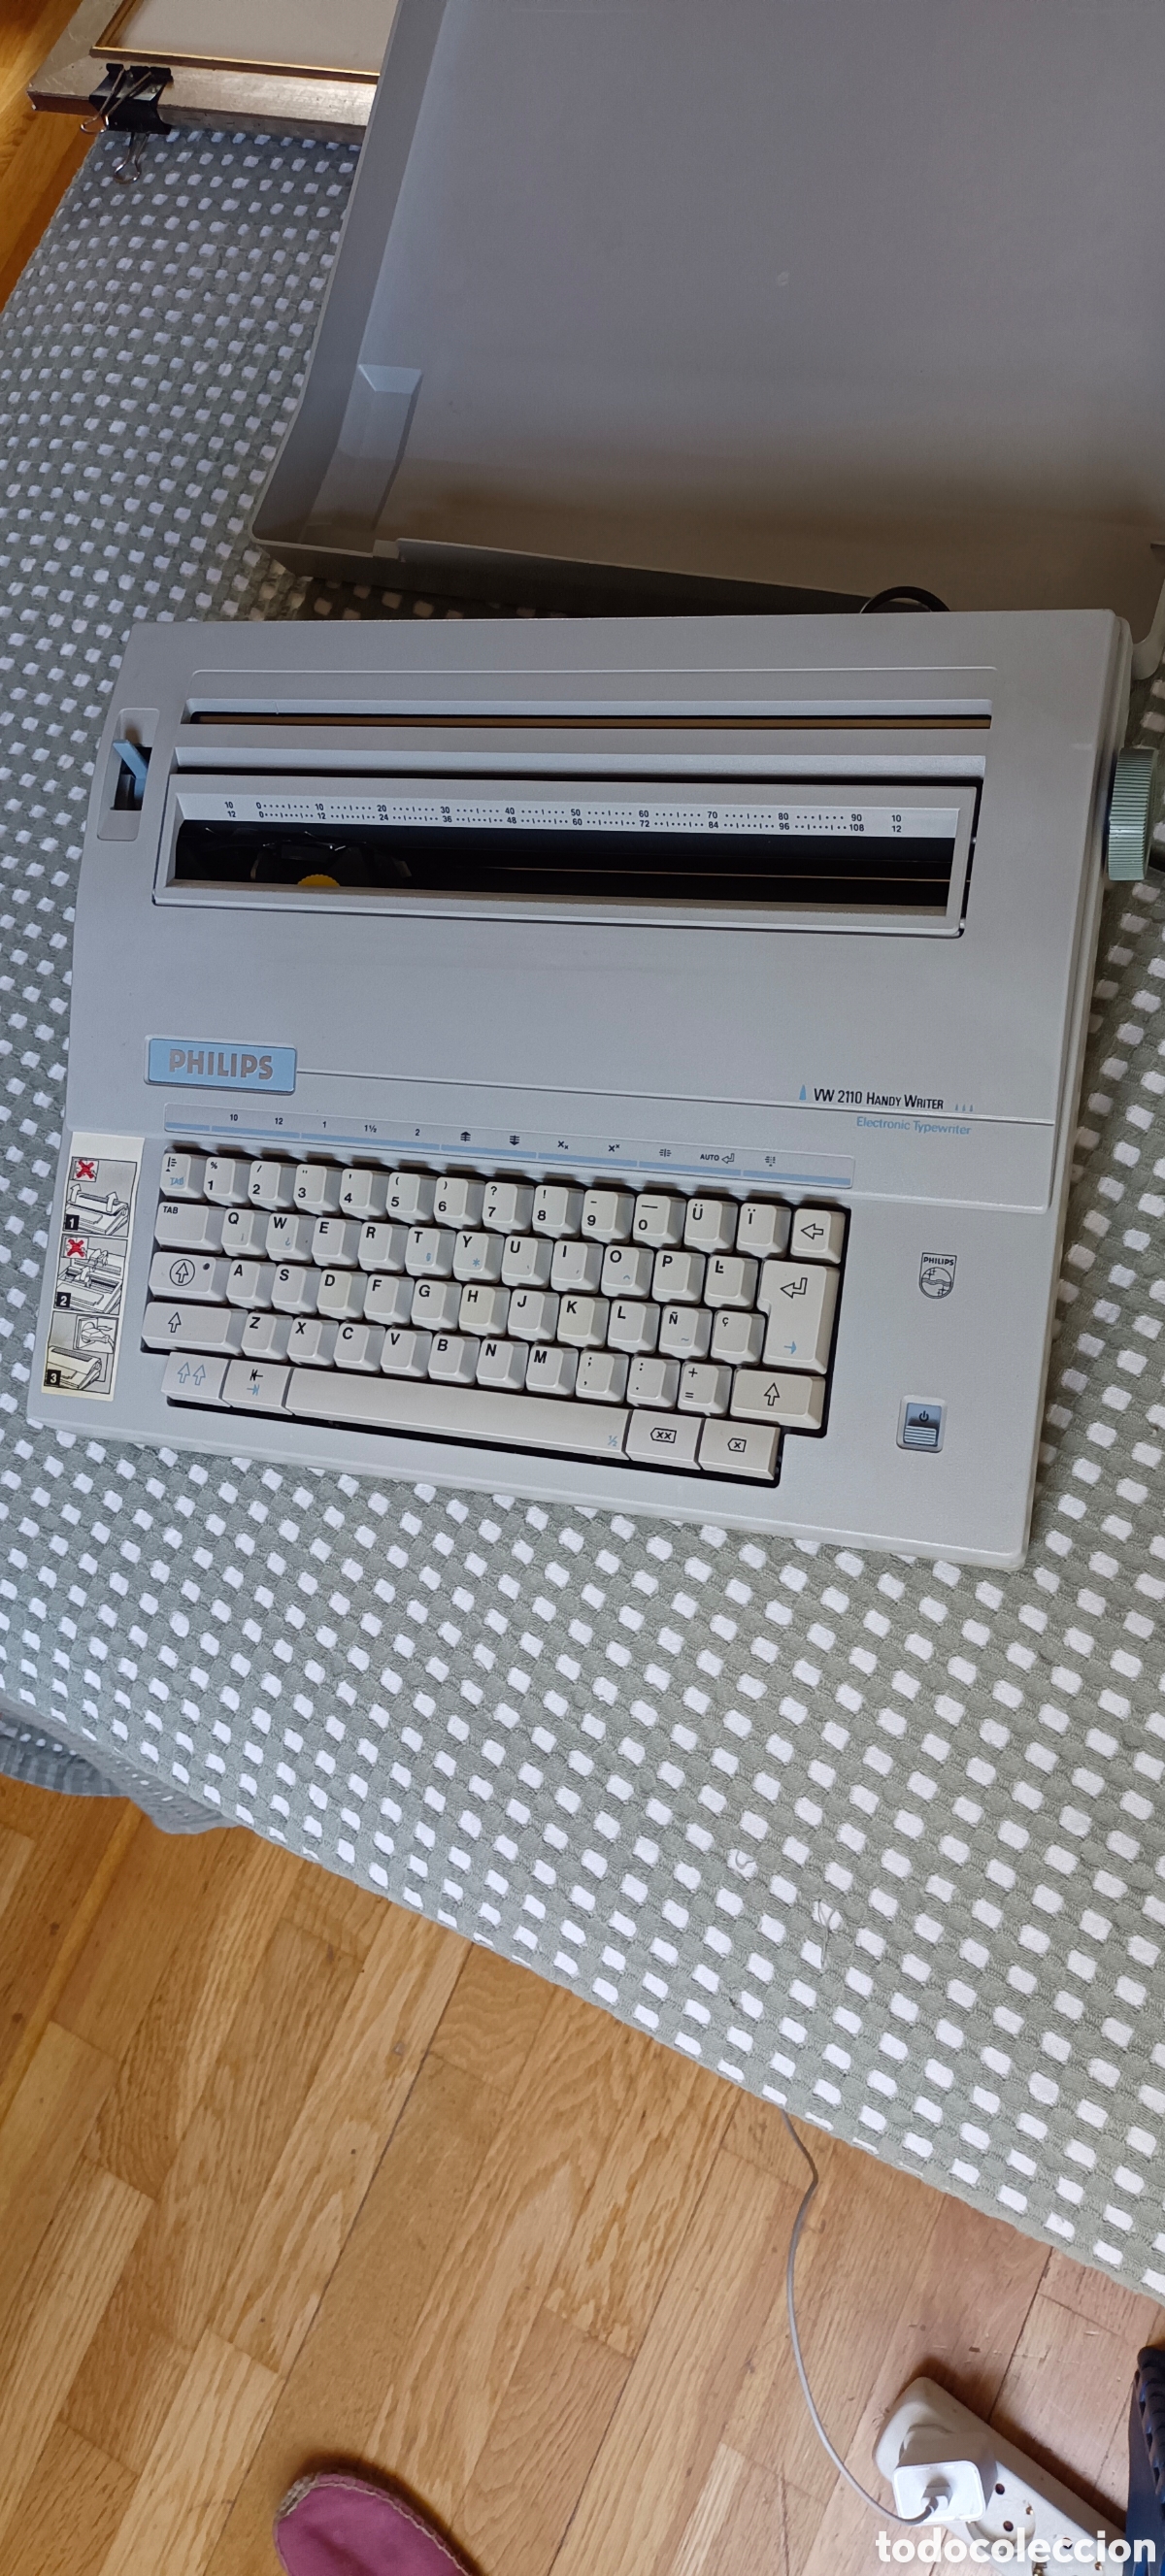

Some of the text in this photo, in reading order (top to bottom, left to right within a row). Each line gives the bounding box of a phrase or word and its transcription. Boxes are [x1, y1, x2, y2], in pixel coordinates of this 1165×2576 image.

[169, 1048, 273, 1080] PHILIPS
[815, 1088, 943, 1108] VW 2110 HANDY WRITER
[856, 1116, 972, 1135] Electronic Typewriter
[170, 1175, 648, 1230] TAB 1 2 3 4 5 6 7 8 9 0
[491, 1186, 497, 1195] ?
[693, 1204, 703, 1220] Ü
[228, 1212, 239, 1224] Q
[274, 1217, 287, 1229] W
[319, 1222, 329, 1234] E
[366, 1227, 376, 1238] R
[415, 1232, 422, 1242] T
[463, 1236, 472, 1247] Y
[511, 1240, 520, 1253] U
[562, 1245, 568, 1257] I
[611, 1250, 621, 1263] O
[662, 1255, 673, 1267] P
[923, 1257, 953, 1266] PHILIPS
[60, 1294, 68, 1306] 2
[234, 1265, 242, 1275] A
[280, 1270, 289, 1281] S
[325, 1274, 335, 1286] D
[373, 1279, 382, 1291] F
[419, 1285, 430, 1297] G
[468, 1290, 478, 1303] H
[517, 1296, 526, 1307] J
[567, 1301, 577, 1313] K
[617, 1306, 625, 1319] L
[669, 1312, 678, 1324] Ñ
[250, 1317, 260, 1329] Z
[296, 1322, 306, 1334] X
[343, 1327, 353, 1339] C
[391, 1333, 400, 1345] V
[438, 1338, 448, 1351] B
[485, 1343, 496, 1356] N
[534, 1350, 547, 1363] M
[688, 1368, 697, 1377] +
[50, 1372, 58, 1384] 3
